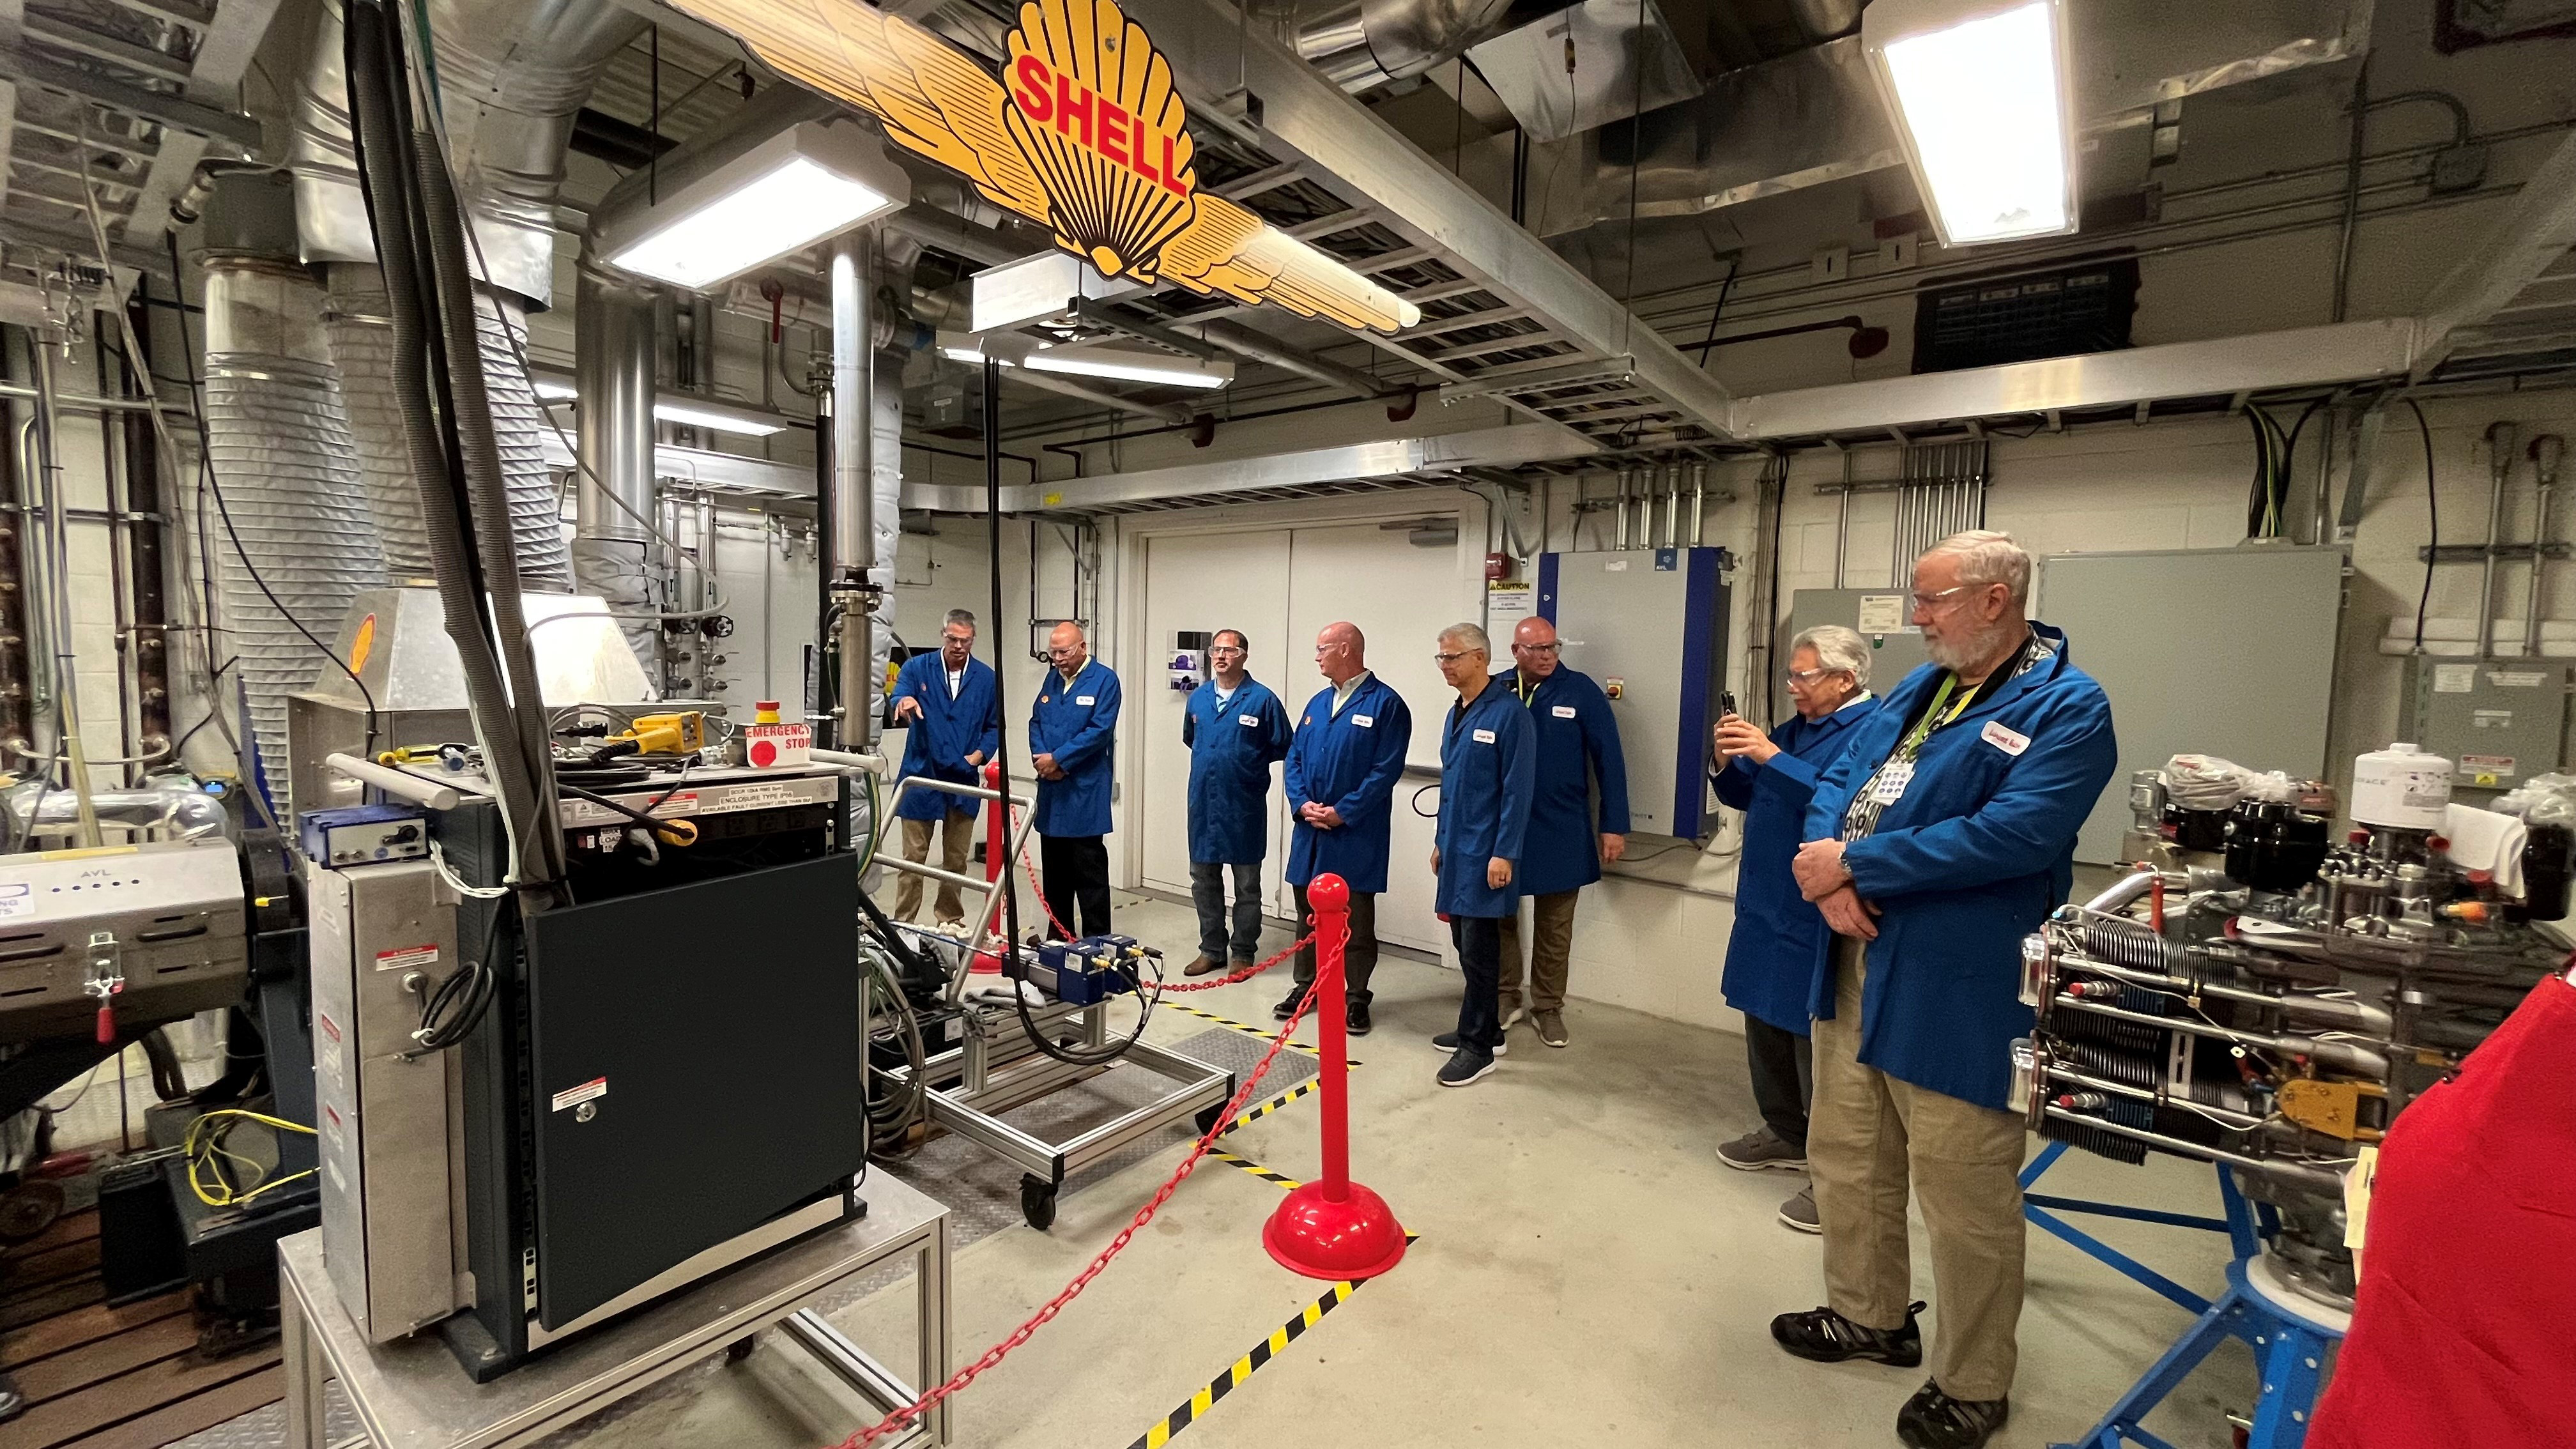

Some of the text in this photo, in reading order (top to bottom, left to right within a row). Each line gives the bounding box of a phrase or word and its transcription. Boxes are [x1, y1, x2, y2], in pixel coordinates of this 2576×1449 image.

[1015, 54, 1187, 197] SHELL
[746, 724, 809, 737] EMERGENCY
[785, 738, 811, 749] STOP
[721, 795, 760, 804] ENCLOSURE
[80, 869, 111, 878] AVL
